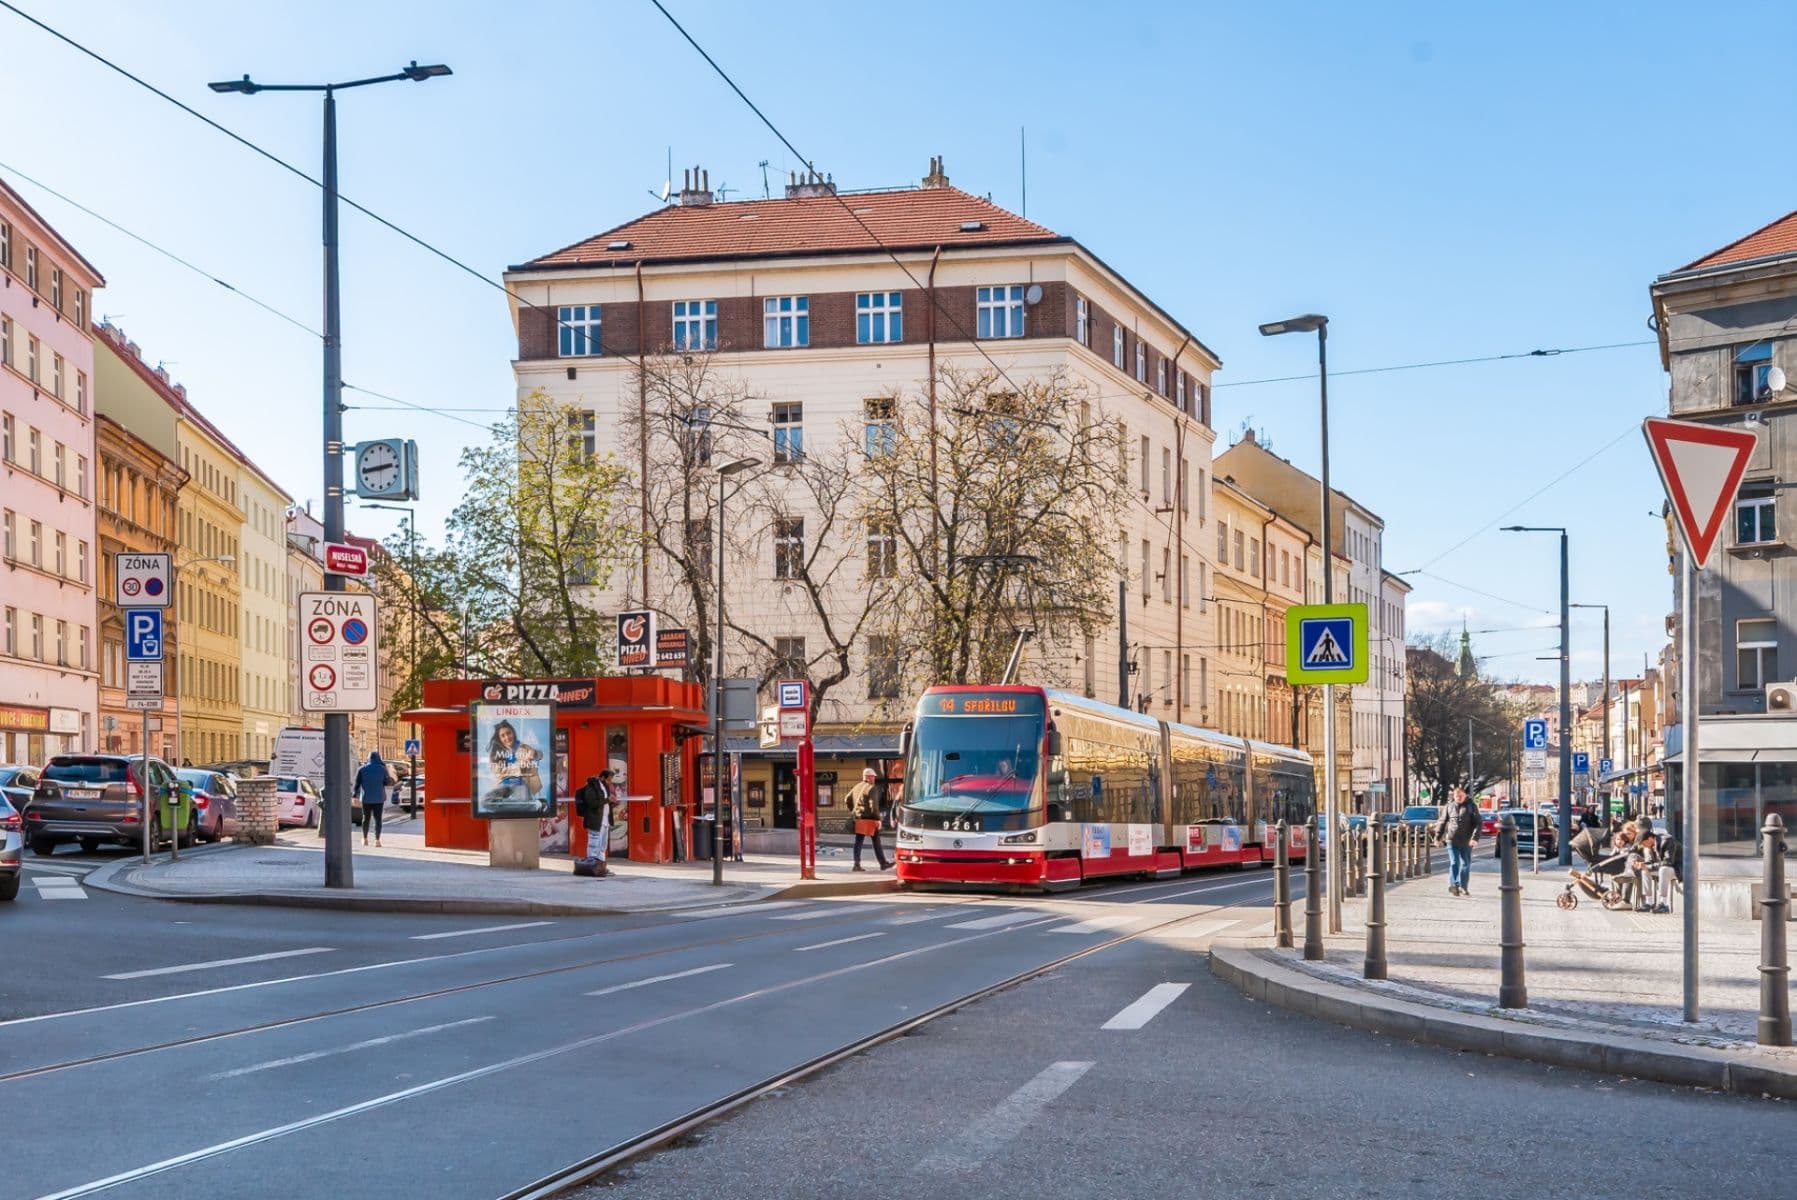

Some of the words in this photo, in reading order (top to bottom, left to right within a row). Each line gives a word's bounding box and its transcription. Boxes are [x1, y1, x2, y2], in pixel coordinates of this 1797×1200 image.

[125, 556, 160, 570] ZÓNA
[126, 582, 137, 592] 30
[312, 597, 362, 616] ZÓNA
[134, 615, 154, 644] P
[620, 644, 646, 655] PIZZA
[661, 652, 673, 660] 642
[673, 651, 686, 660] 659
[507, 684, 561, 701] PIZZA
[939, 698, 955, 712] 14
[964, 697, 1016, 713] SPOŘILOV
[496, 708, 531, 716] LINDEX
[1529, 723, 1543, 740] P
[1576, 754, 1586, 766] P
[943, 820, 980, 832] 9261
